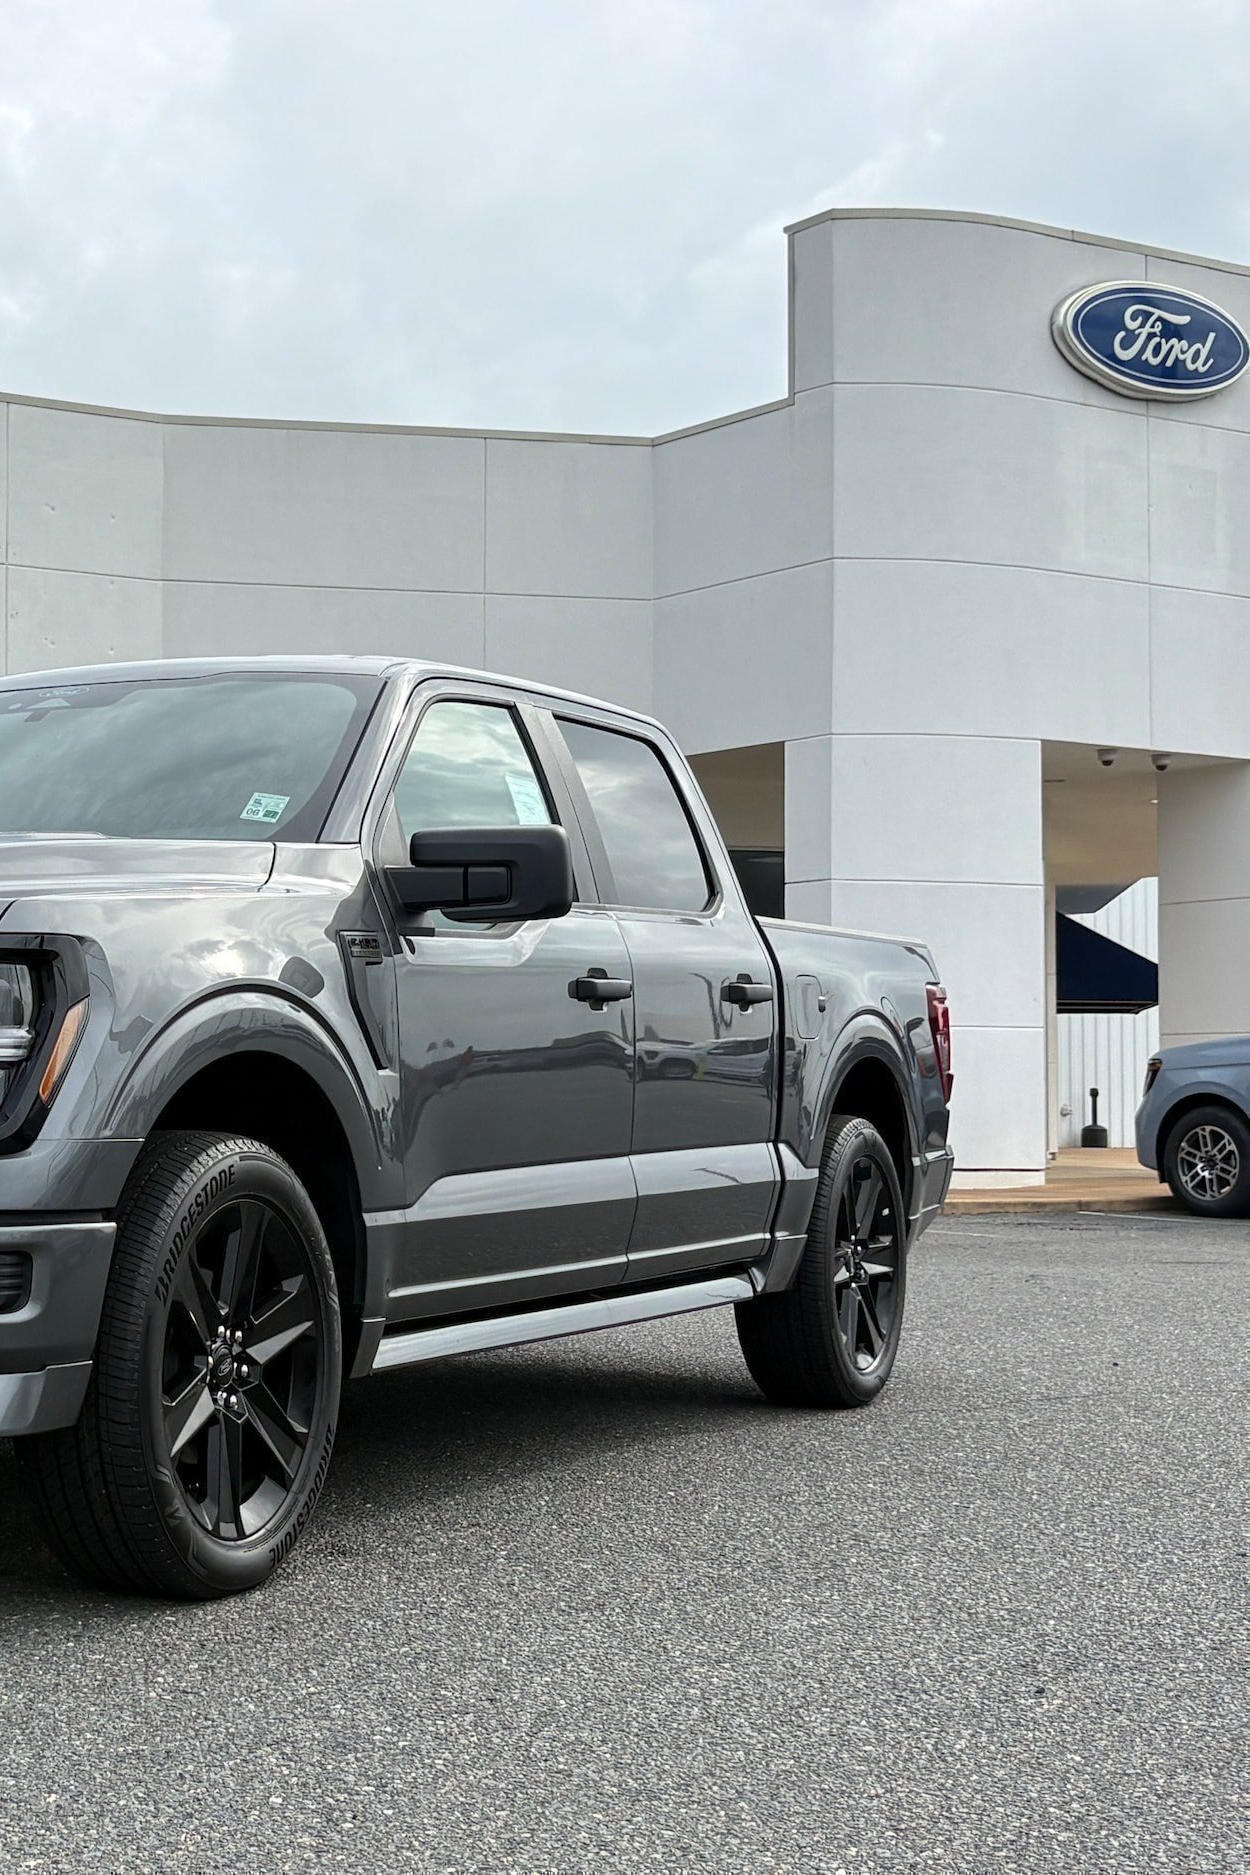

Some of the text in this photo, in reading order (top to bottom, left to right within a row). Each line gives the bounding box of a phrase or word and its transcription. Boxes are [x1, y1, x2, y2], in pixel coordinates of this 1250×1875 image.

[1113, 304, 1216, 373] Ford
[155, 1164, 236, 1308] BRIDGESTONE
[269, 1423, 335, 1571] BRIDGESTONE
